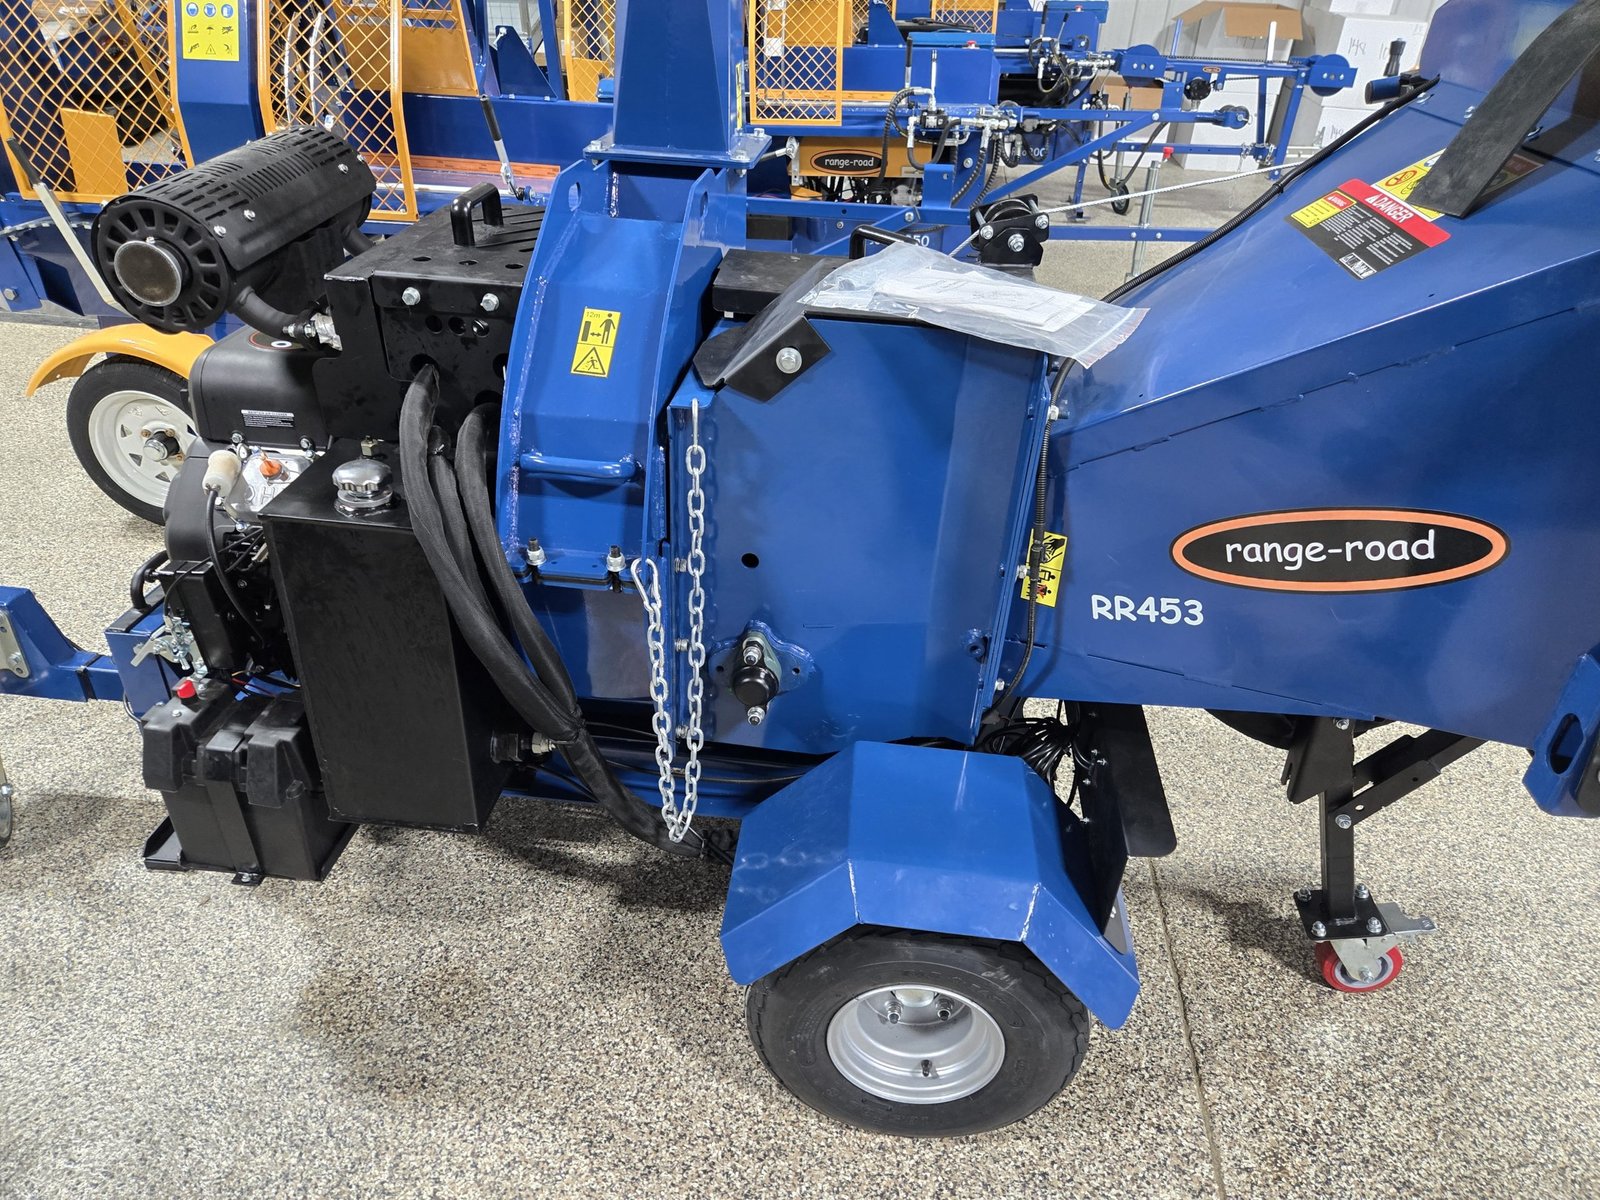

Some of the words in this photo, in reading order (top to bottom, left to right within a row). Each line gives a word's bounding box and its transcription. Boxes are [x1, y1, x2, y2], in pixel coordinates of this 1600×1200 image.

[824, 157, 875, 169] range-road
[1372, 196, 1415, 223] DANGER
[586, 311, 601, 319] 12m
[1225, 528, 1435, 571] range-road
[1091, 594, 1204, 626] RR453
